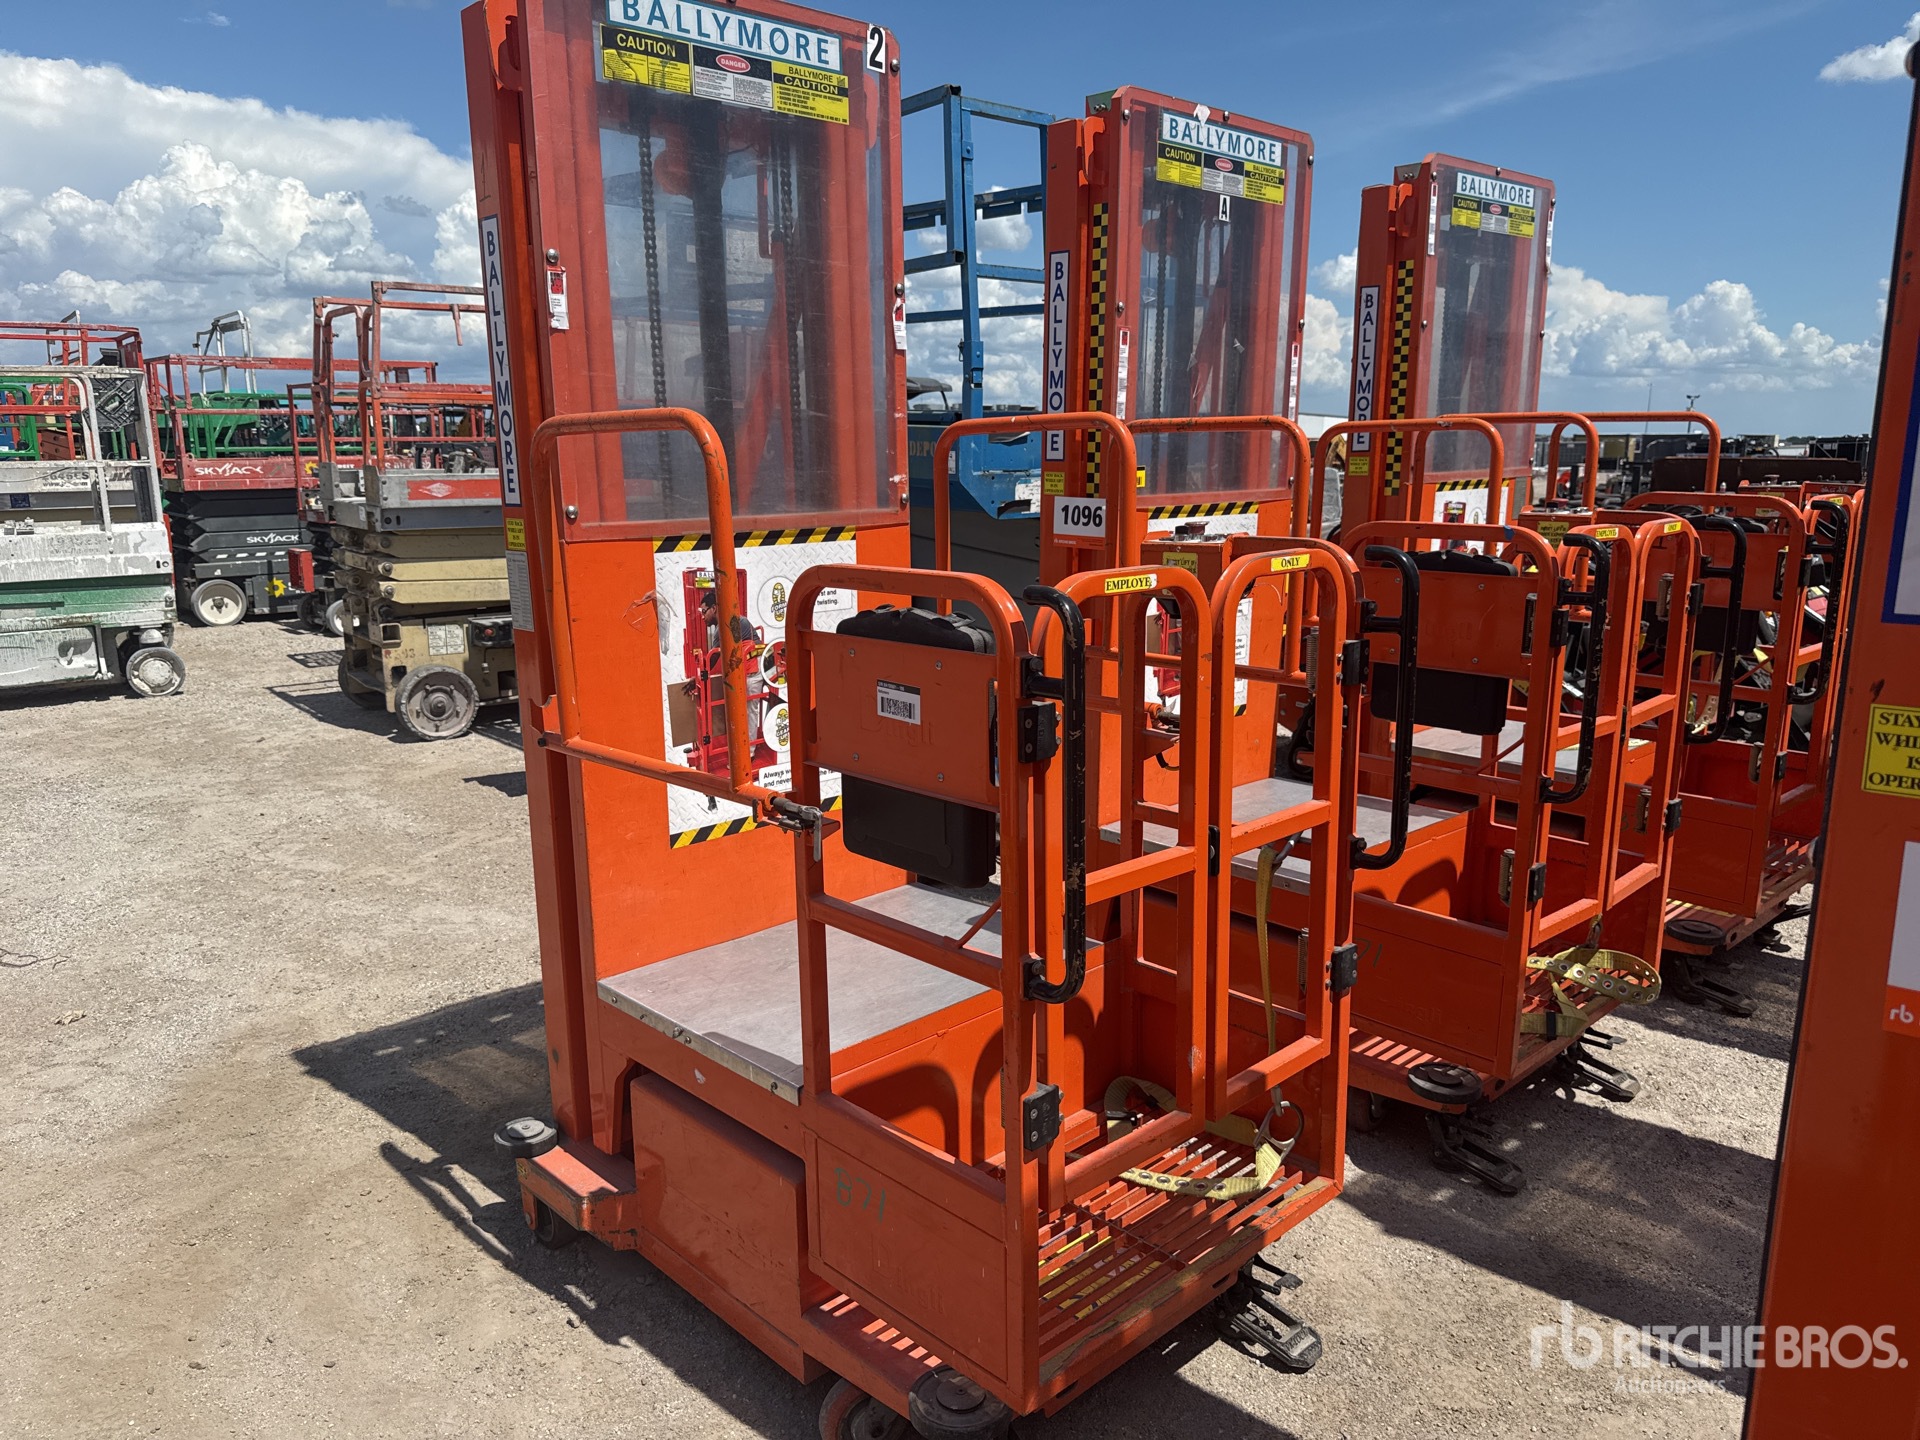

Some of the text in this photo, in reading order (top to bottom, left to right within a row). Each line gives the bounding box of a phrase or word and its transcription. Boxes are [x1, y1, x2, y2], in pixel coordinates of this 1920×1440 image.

[623, 0, 829, 64] BALLYMORE
[616, 33, 676, 58] CAUTION
[869, 27, 884, 70] 2
[720, 58, 746, 69] DANGER
[788, 66, 834, 83] BALLYMORE
[784, 76, 839, 95] CAUTION
[1169, 117, 1276, 163] BALLYMORE
[1165, 147, 1196, 163] CAUTION
[1250, 172, 1280, 184] CAUTION
[1461, 175, 1531, 205] BALLYMORE
[1220, 198, 1229, 221] A
[1457, 198, 1478, 209] CAUTION
[486, 230, 515, 493] BALLYMORE
[1049, 261, 1064, 452] BALLYMOE
[1061, 505, 1103, 528] 1096
[246, 533, 299, 544] SKYJACK
[1280, 557, 1301, 568] ONLY
[1106, 576, 1154, 591] EMPLOYE
[1875, 731, 1920, 749] WHI
[763, 770, 785, 779] Always
[1889, 1003, 1915, 1024] rb
